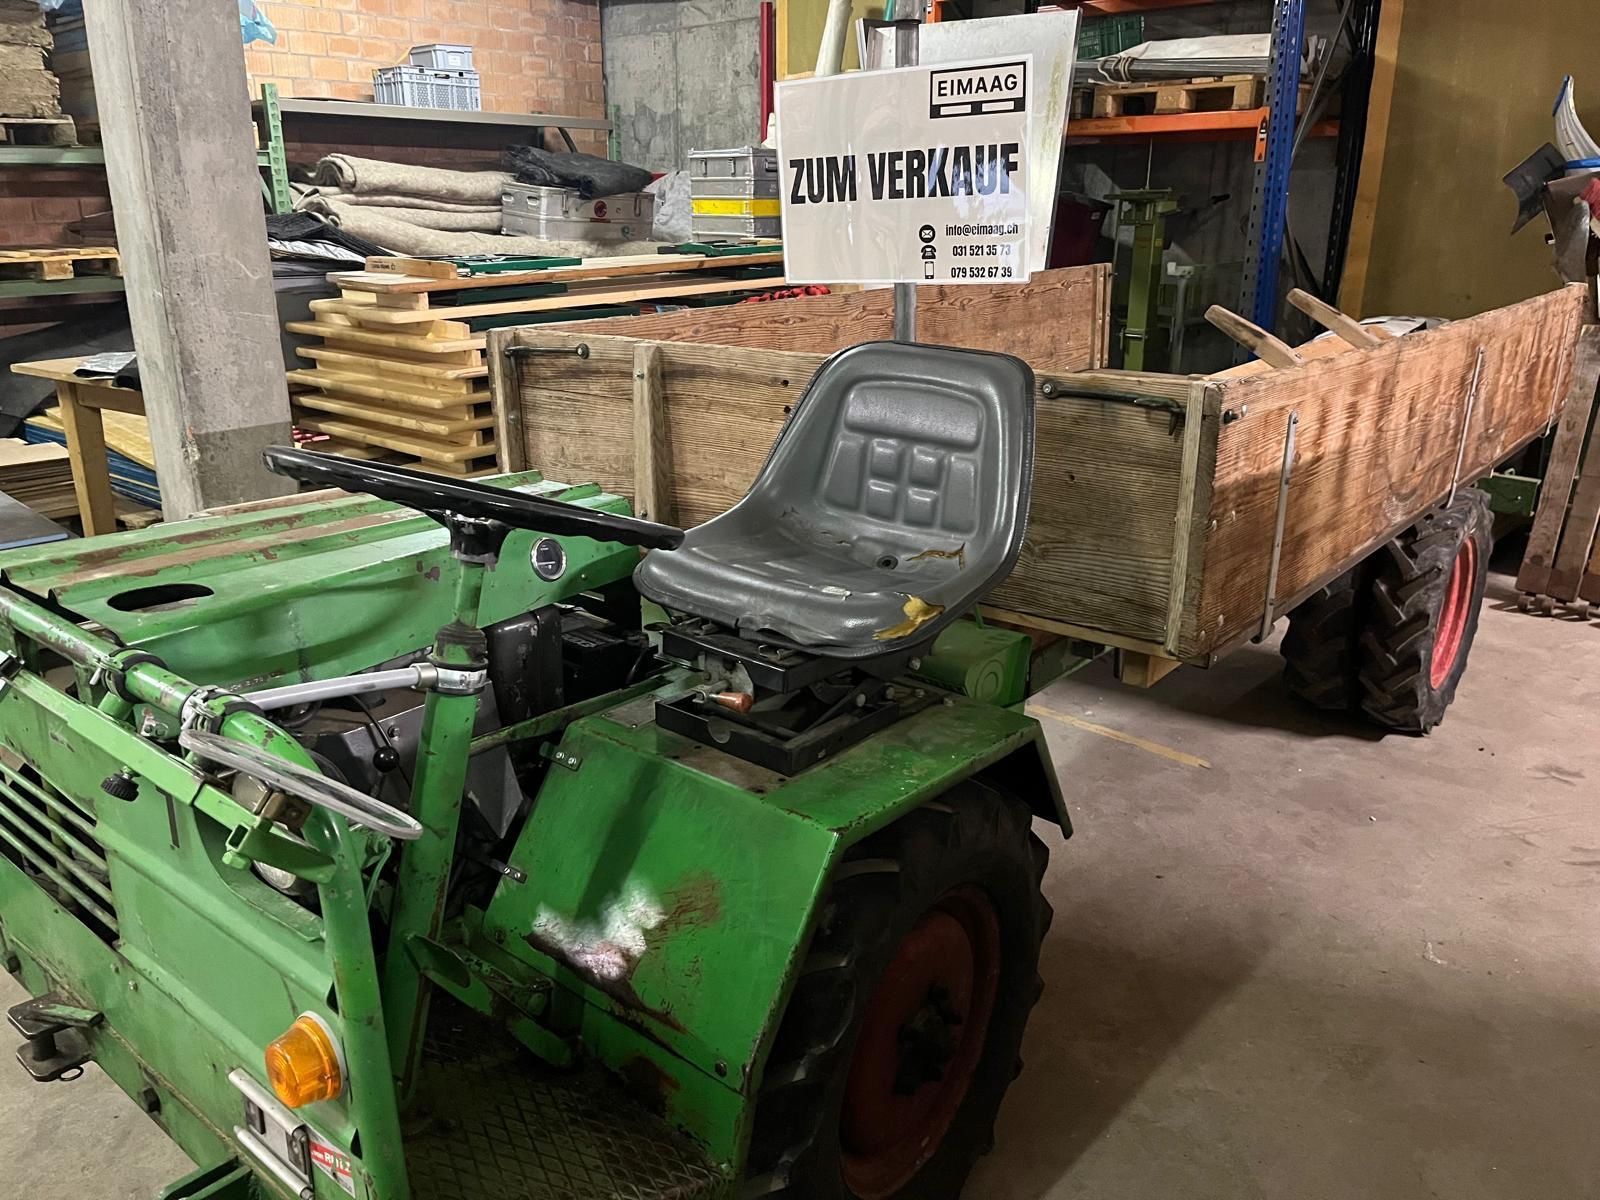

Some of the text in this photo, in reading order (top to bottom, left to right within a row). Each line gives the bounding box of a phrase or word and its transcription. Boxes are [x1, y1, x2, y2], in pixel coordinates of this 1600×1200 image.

[937, 73, 1018, 97] EIMAAG
[789, 142, 1019, 205] ZUM VERKAUF
[945, 223, 1019, 237] info@eimaag.ch
[952, 243, 1012, 257] 031 521 35 73
[951, 266, 1013, 278] 079 532 67 39
